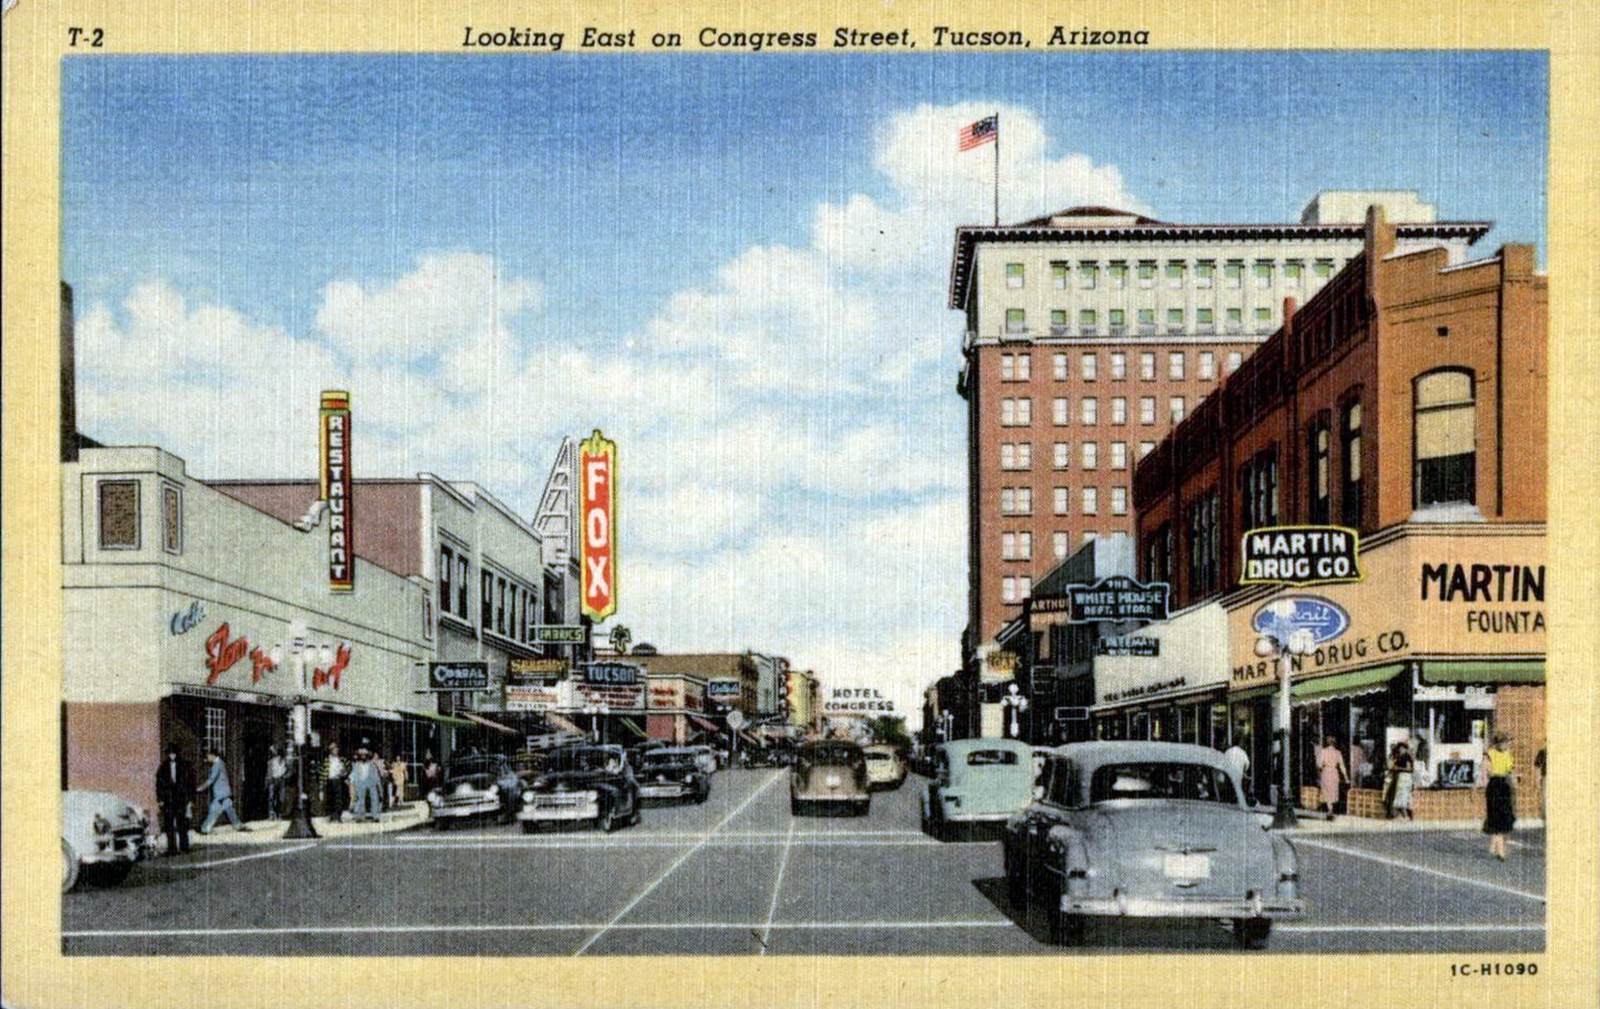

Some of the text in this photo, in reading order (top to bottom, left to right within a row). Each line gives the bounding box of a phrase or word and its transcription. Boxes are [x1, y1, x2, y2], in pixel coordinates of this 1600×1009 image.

[329, 415, 346, 579] RESTAURANT
[587, 461, 609, 597] FOX
[1252, 532, 1346, 556] MARTIN
[1249, 557, 1310, 579] DRUG
[1107, 580, 1129, 589] THE
[1421, 562, 1546, 602] MARTIN
[1075, 591, 1162, 604] WHITE HOUSE
[1467, 610, 1546, 633] FOUNTA
[1232, 657, 1302, 682] MARTN
[1314, 638, 1367, 667] DRUG
[588, 666, 636, 683] TUCSON
[833, 688, 883, 699] HOTEL
[825, 701, 895, 712] CONGRESS
